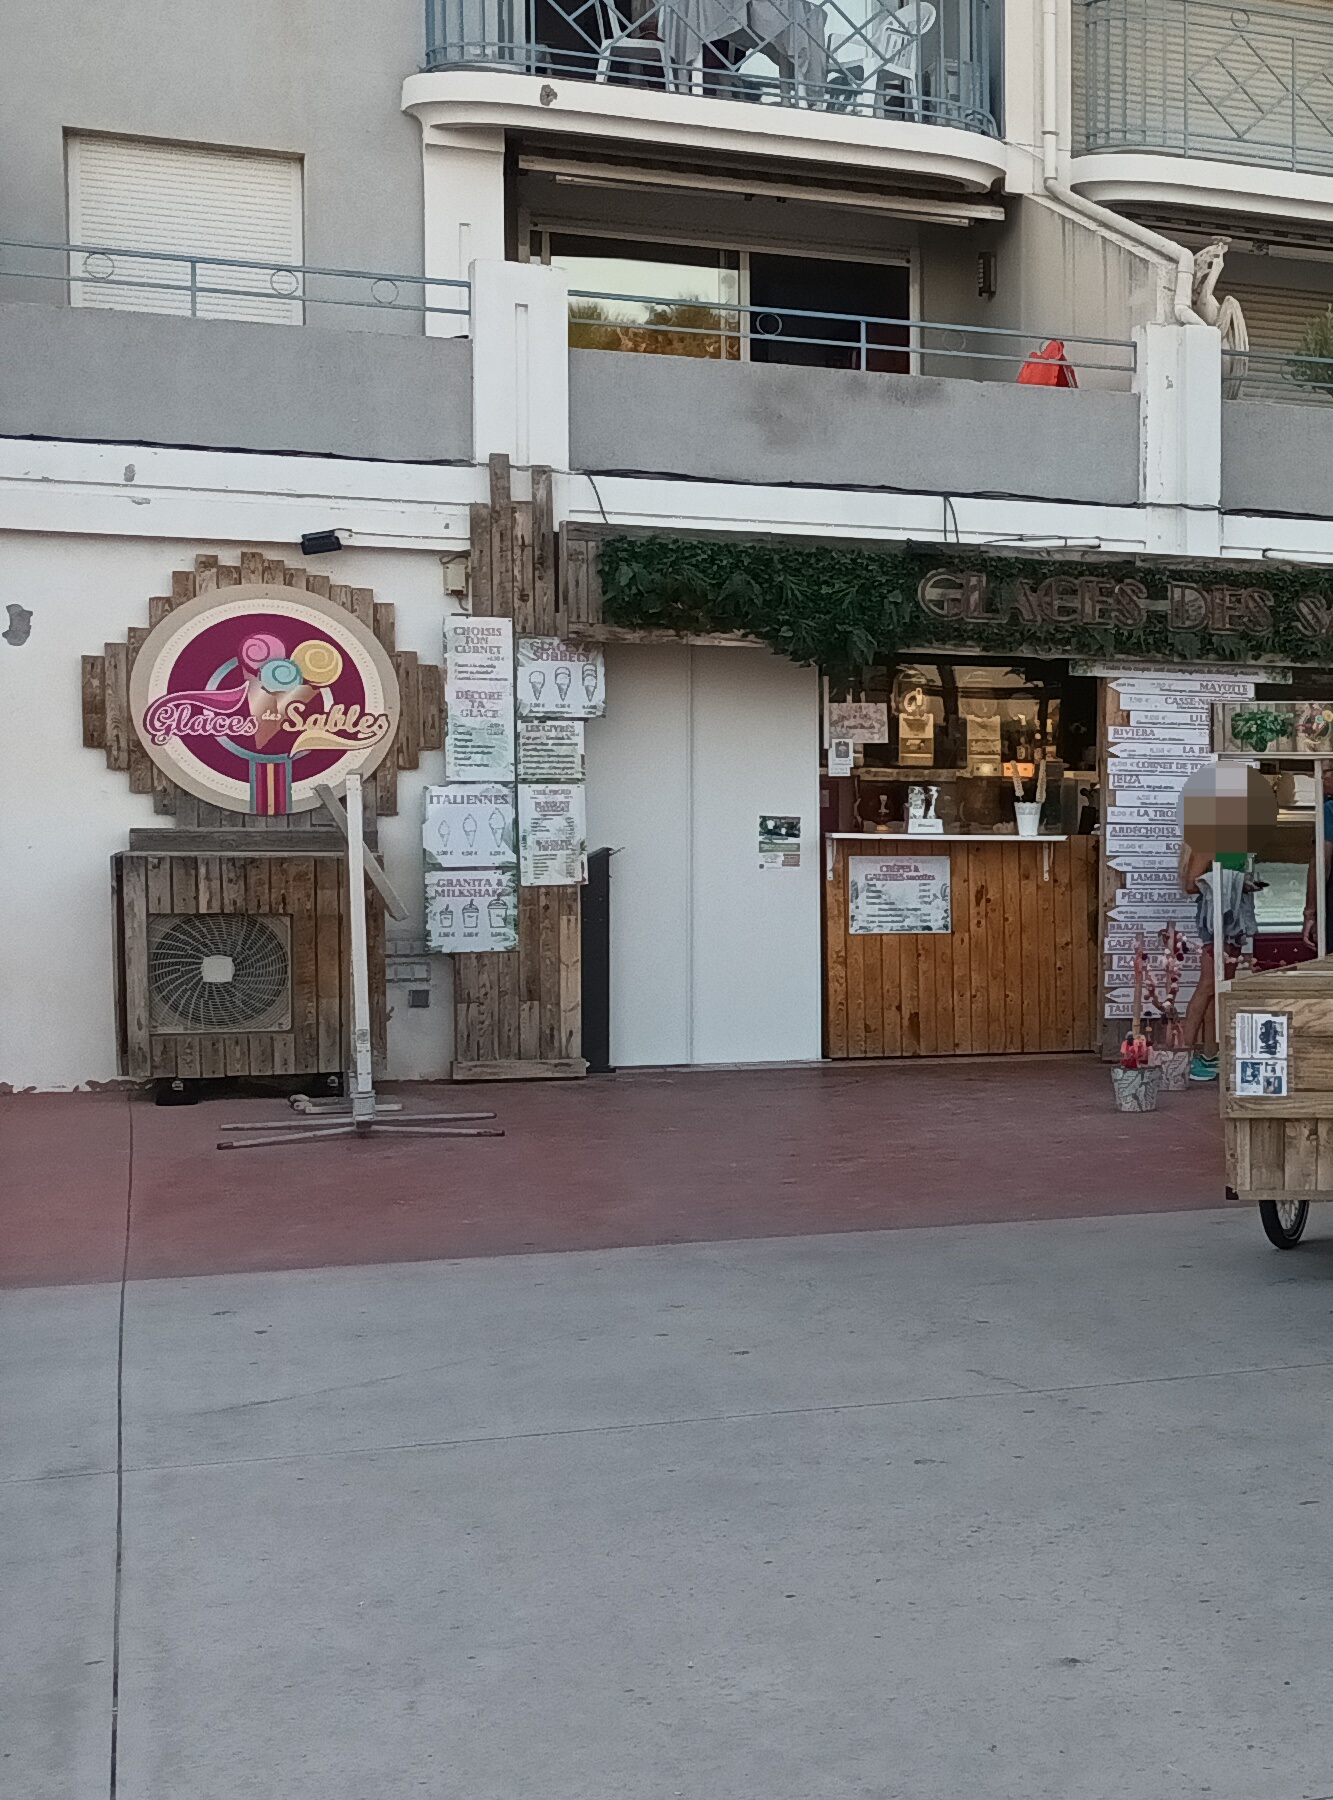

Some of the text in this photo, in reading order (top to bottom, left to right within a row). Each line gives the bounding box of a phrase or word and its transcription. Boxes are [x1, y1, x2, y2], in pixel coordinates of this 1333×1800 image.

[917, 566, 1148, 630] GLACES
[1167, 580, 1273, 635] DES
[144, 696, 391, 746] Glaces des Sables
[428, 794, 510, 805] ITALIENNES
